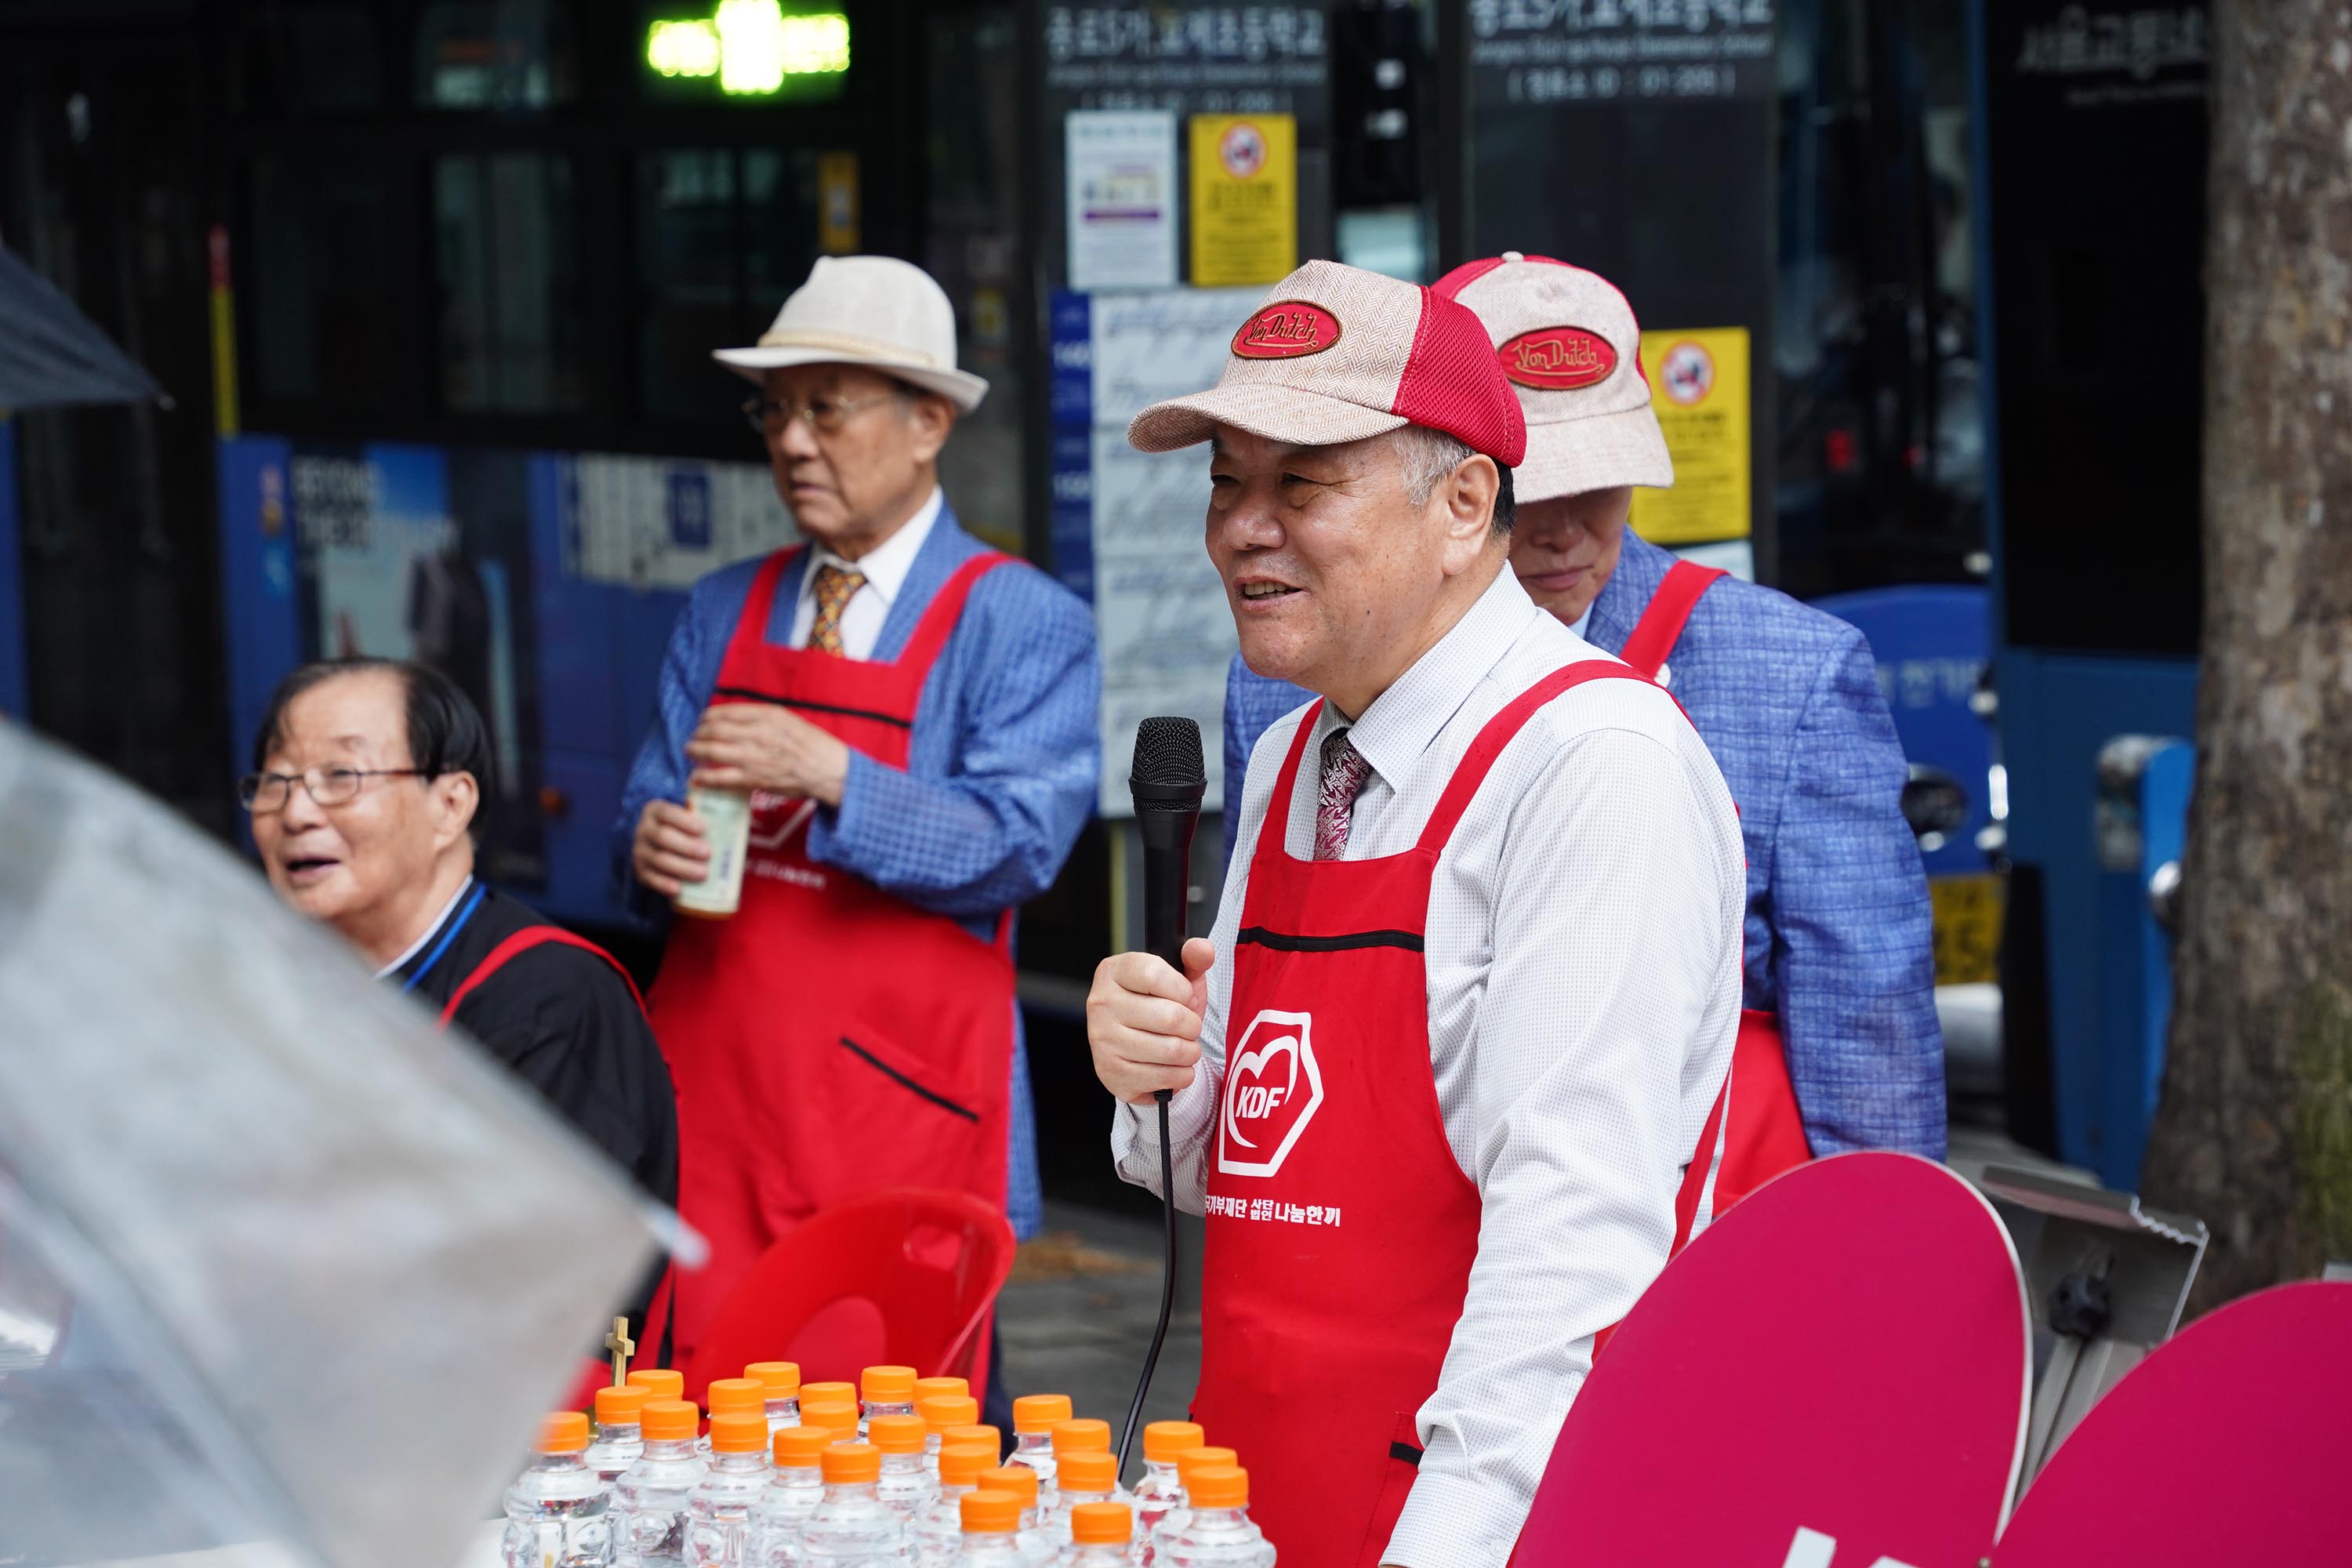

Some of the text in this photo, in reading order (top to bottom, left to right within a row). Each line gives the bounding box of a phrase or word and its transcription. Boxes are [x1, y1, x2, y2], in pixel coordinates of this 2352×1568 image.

[1265, 312, 1317, 341] Dutch
[1512, 339, 1598, 369] Von Dutch
[1236, 1086, 1286, 1119] KDF
[1275, 1203, 1341, 1227] 나눔한끼
